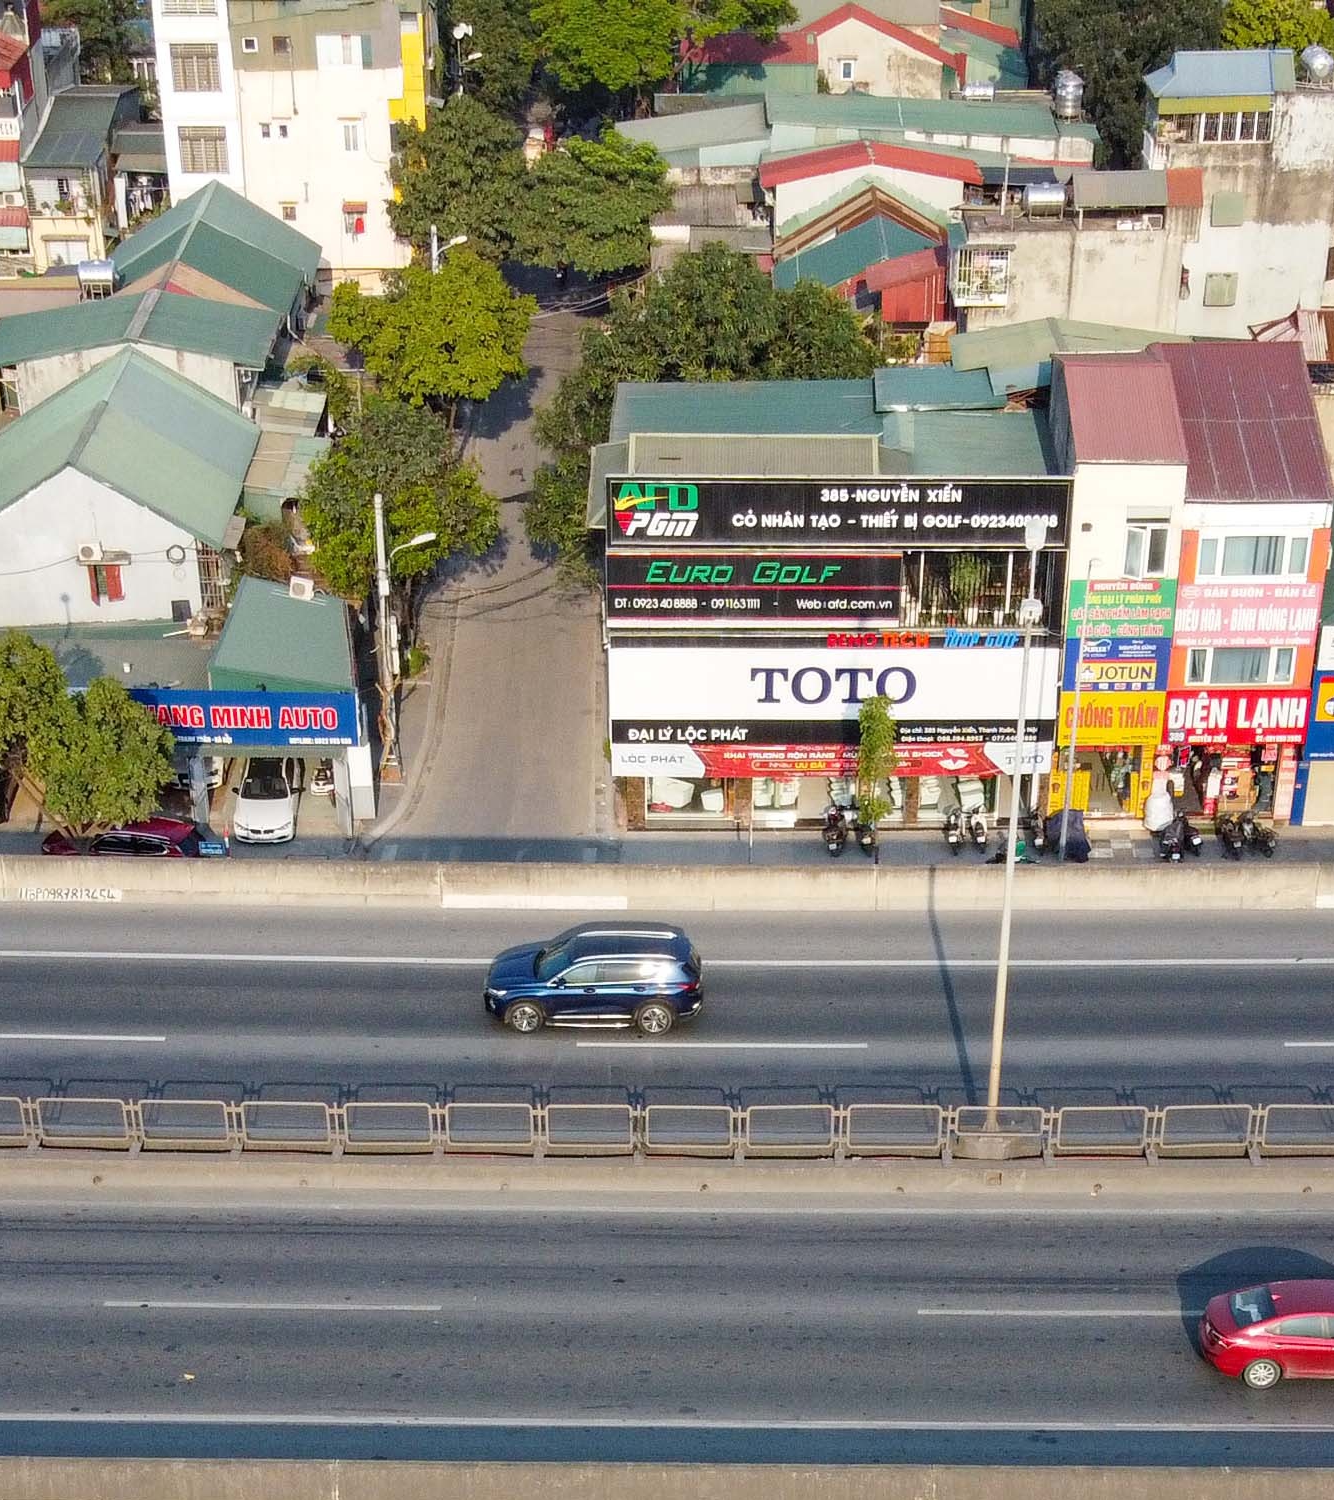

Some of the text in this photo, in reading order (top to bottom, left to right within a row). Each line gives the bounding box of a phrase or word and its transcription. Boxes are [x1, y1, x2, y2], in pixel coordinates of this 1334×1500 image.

[926, 483, 963, 503] XIỂN
[625, 511, 699, 537] PGM
[731, 508, 918, 531] CỎ NHÂN TẠO THIẾT BỊ
[752, 561, 842, 584] GOLF
[827, 599, 893, 611] afd.com.vn
[1096, 666, 1153, 680] JOTUN
[750, 666, 917, 705] TOTO
[210, 705, 272, 729] MINH
[278, 706, 339, 731] AUTO
[1168, 692, 1308, 734] ĐIỆN LẠNH
[627, 725, 748, 744] ĐẠI LÝ LỘC PHÁT
